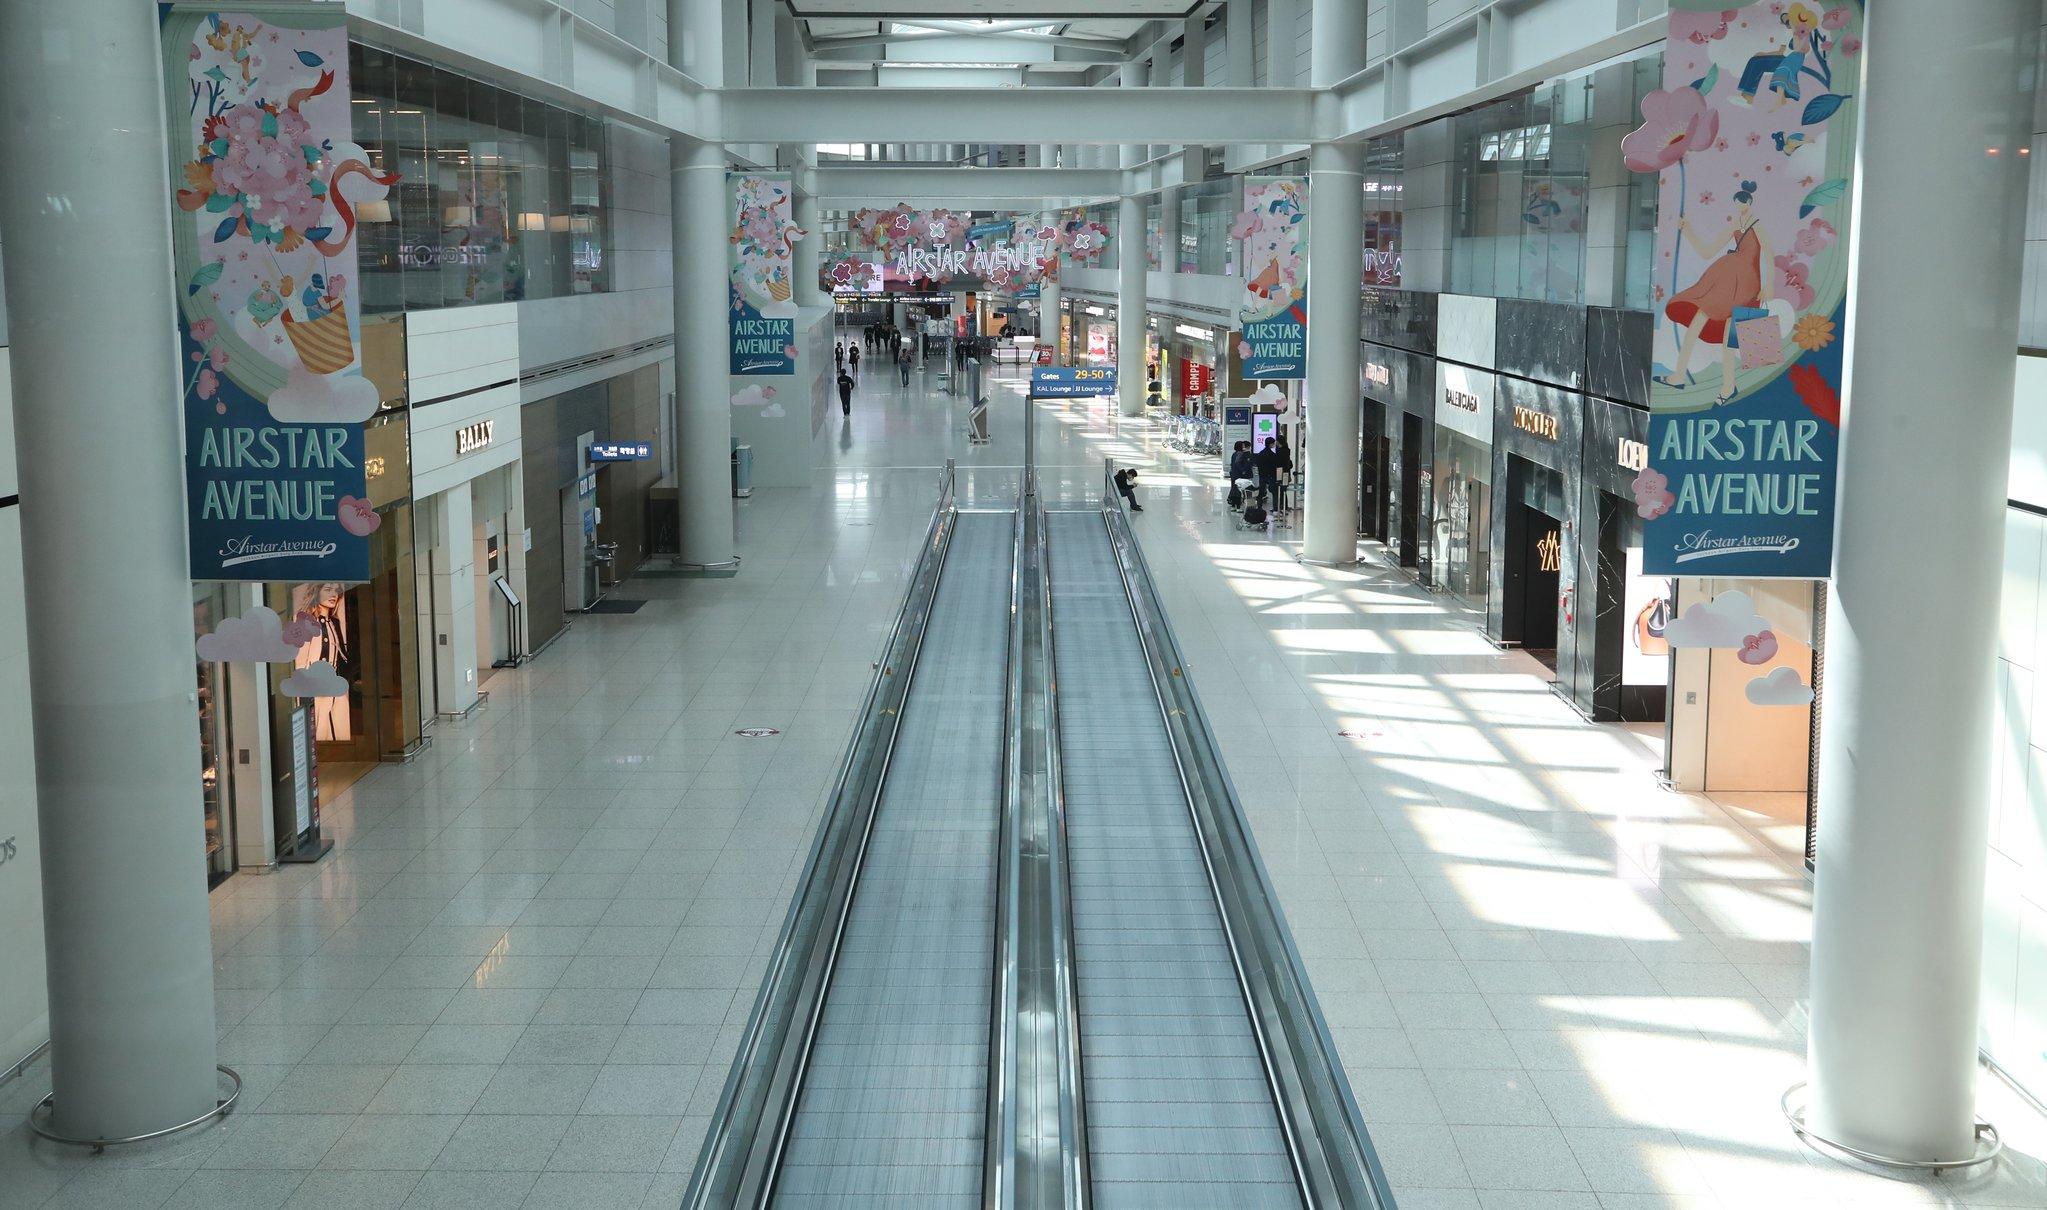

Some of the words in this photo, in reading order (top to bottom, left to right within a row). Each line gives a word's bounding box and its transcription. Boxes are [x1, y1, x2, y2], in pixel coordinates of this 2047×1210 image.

[896, 243, 969, 279] AIRSTAR
[973, 240, 1045, 275] AVENUE
[735, 320, 790, 335] AIRSTAR
[1247, 323, 1302, 339] AIRSTAR
[735, 339, 784, 354] AVENUE
[1253, 343, 1302, 358] AVENUE
[1075, 369, 1104, 379] 29-50
[1513, 406, 1557, 440] MONCLER
[200, 427, 356, 469] AIRSTAR
[457, 420, 494, 454] BALLY
[1659, 418, 1823, 462] AIRSTAR
[202, 480, 336, 521] AVENUE
[1675, 473, 1820, 515] AVENUE
[219, 535, 279, 556] Airstar
[278, 540, 324, 551] Avenue
[1674, 530, 1738, 551] Airstar
[1738, 535, 1787, 546] Avenue
